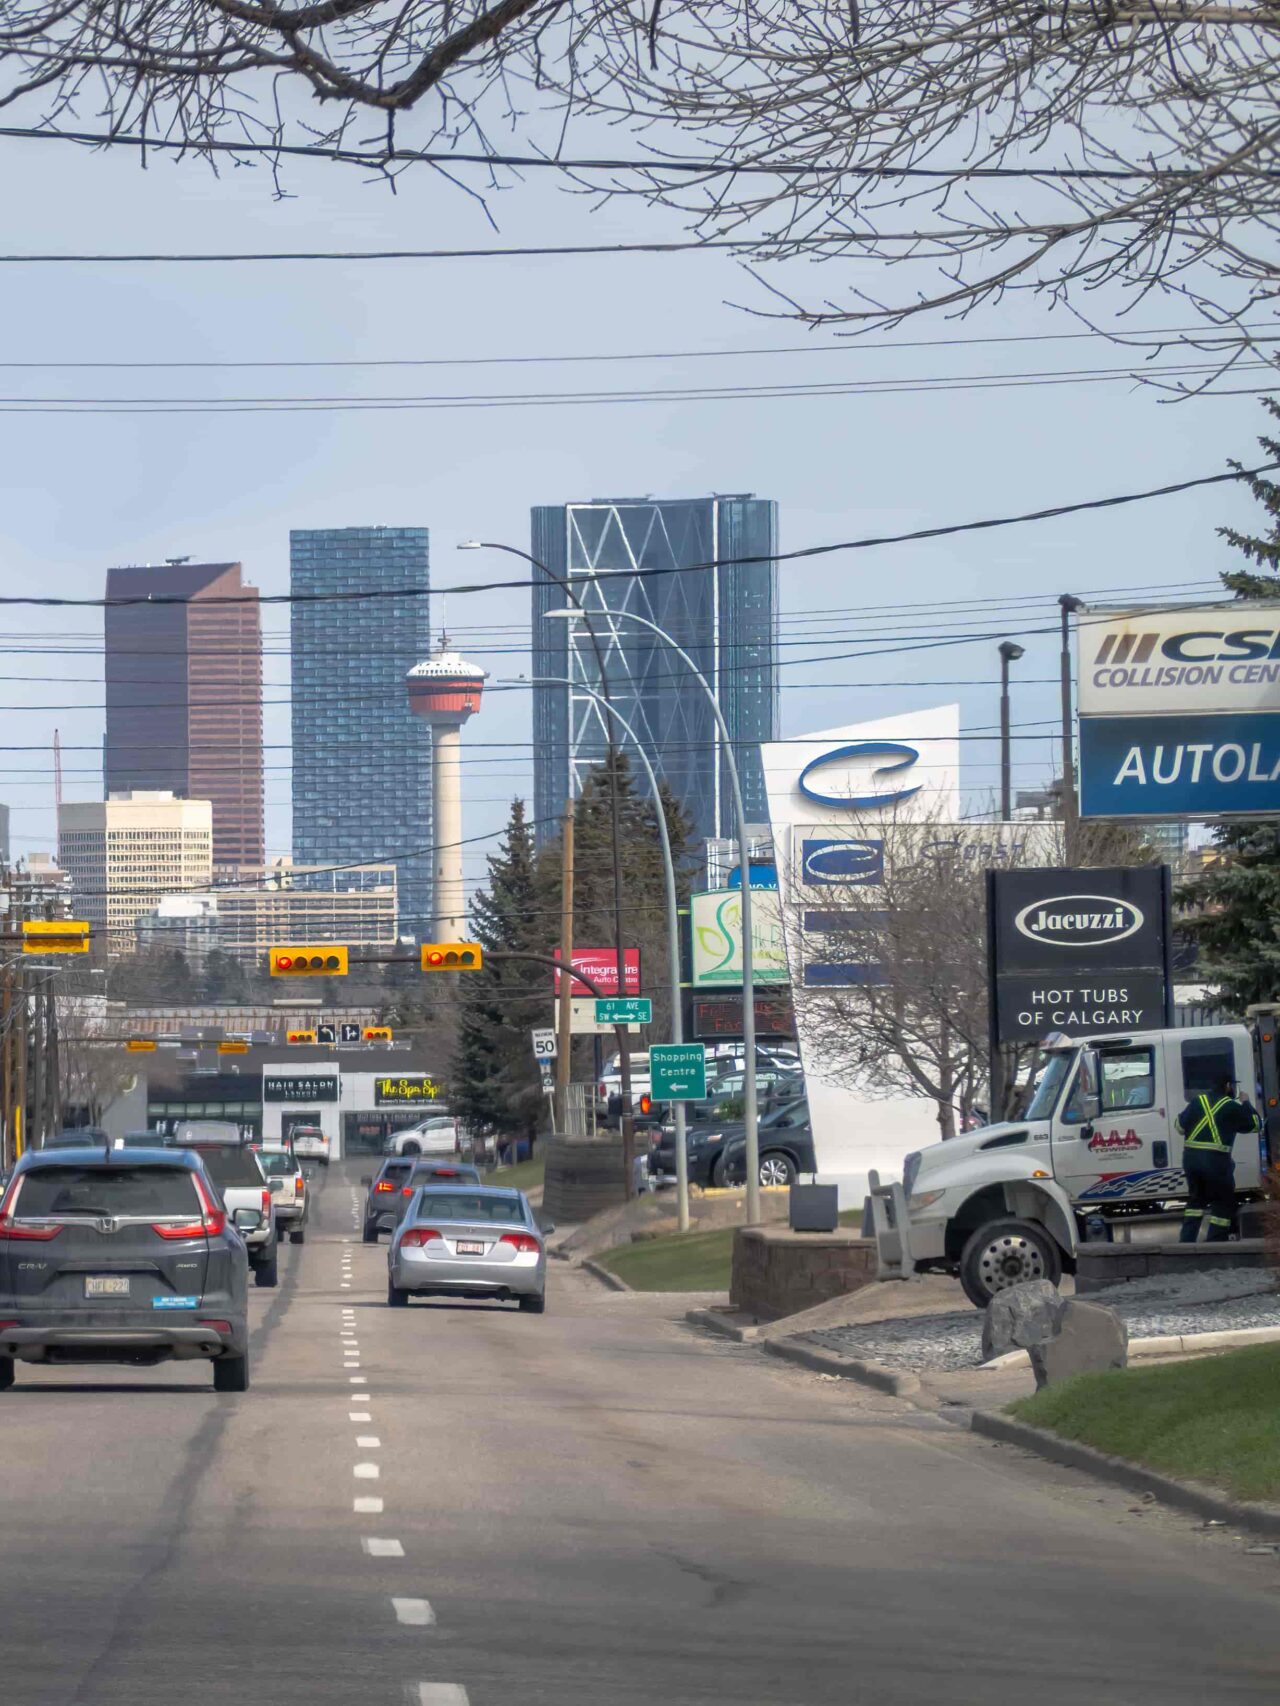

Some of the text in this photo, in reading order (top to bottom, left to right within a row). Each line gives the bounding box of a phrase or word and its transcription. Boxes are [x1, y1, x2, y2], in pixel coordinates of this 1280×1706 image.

[1093, 665, 1224, 688] COLLISION
[1031, 907, 1124, 932] Jacuzzi
[580, 964, 618, 977] Integra
[1031, 989, 1128, 1004] HOT TUBS
[606, 1001, 640, 1011] 61 AVE
[599, 1011, 648, 1021] SW SE
[1018, 1010, 1143, 1026] OF CALGARY
[536, 1040, 555, 1054] 50
[653, 1053, 702, 1062] Shopping
[660, 1068, 696, 1076] Centre
[268, 1081, 294, 1089] HAIR
